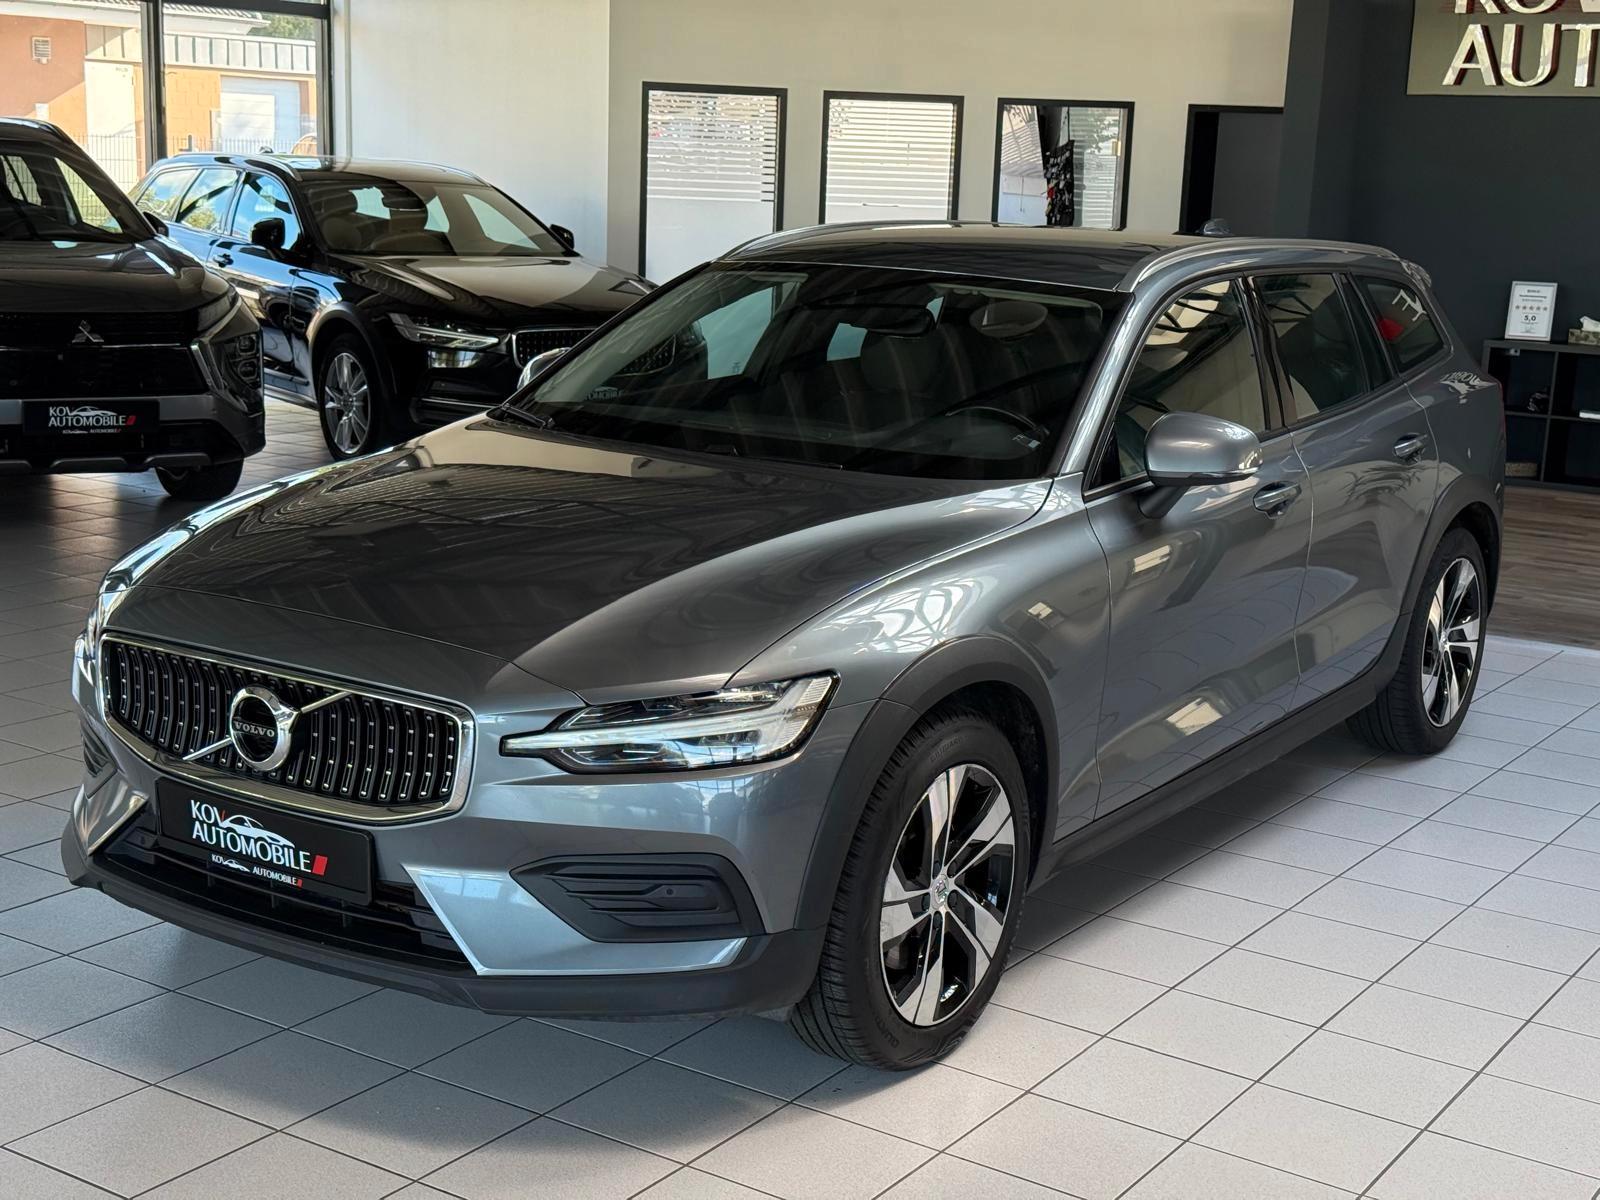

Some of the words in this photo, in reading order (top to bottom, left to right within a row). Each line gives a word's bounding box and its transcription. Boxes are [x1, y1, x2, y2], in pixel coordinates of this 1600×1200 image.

[1441, 24, 1600, 87] AUT
[48, 415, 127, 427] AUTOMOBILE
[49, 406, 72, 416] KOV
[235, 722, 275, 737] VOLVO
[190, 800, 226, 827] KOV
[192, 821, 312, 873] AUTOMOBILE
[252, 866, 297, 886] AUTOMOBILE
